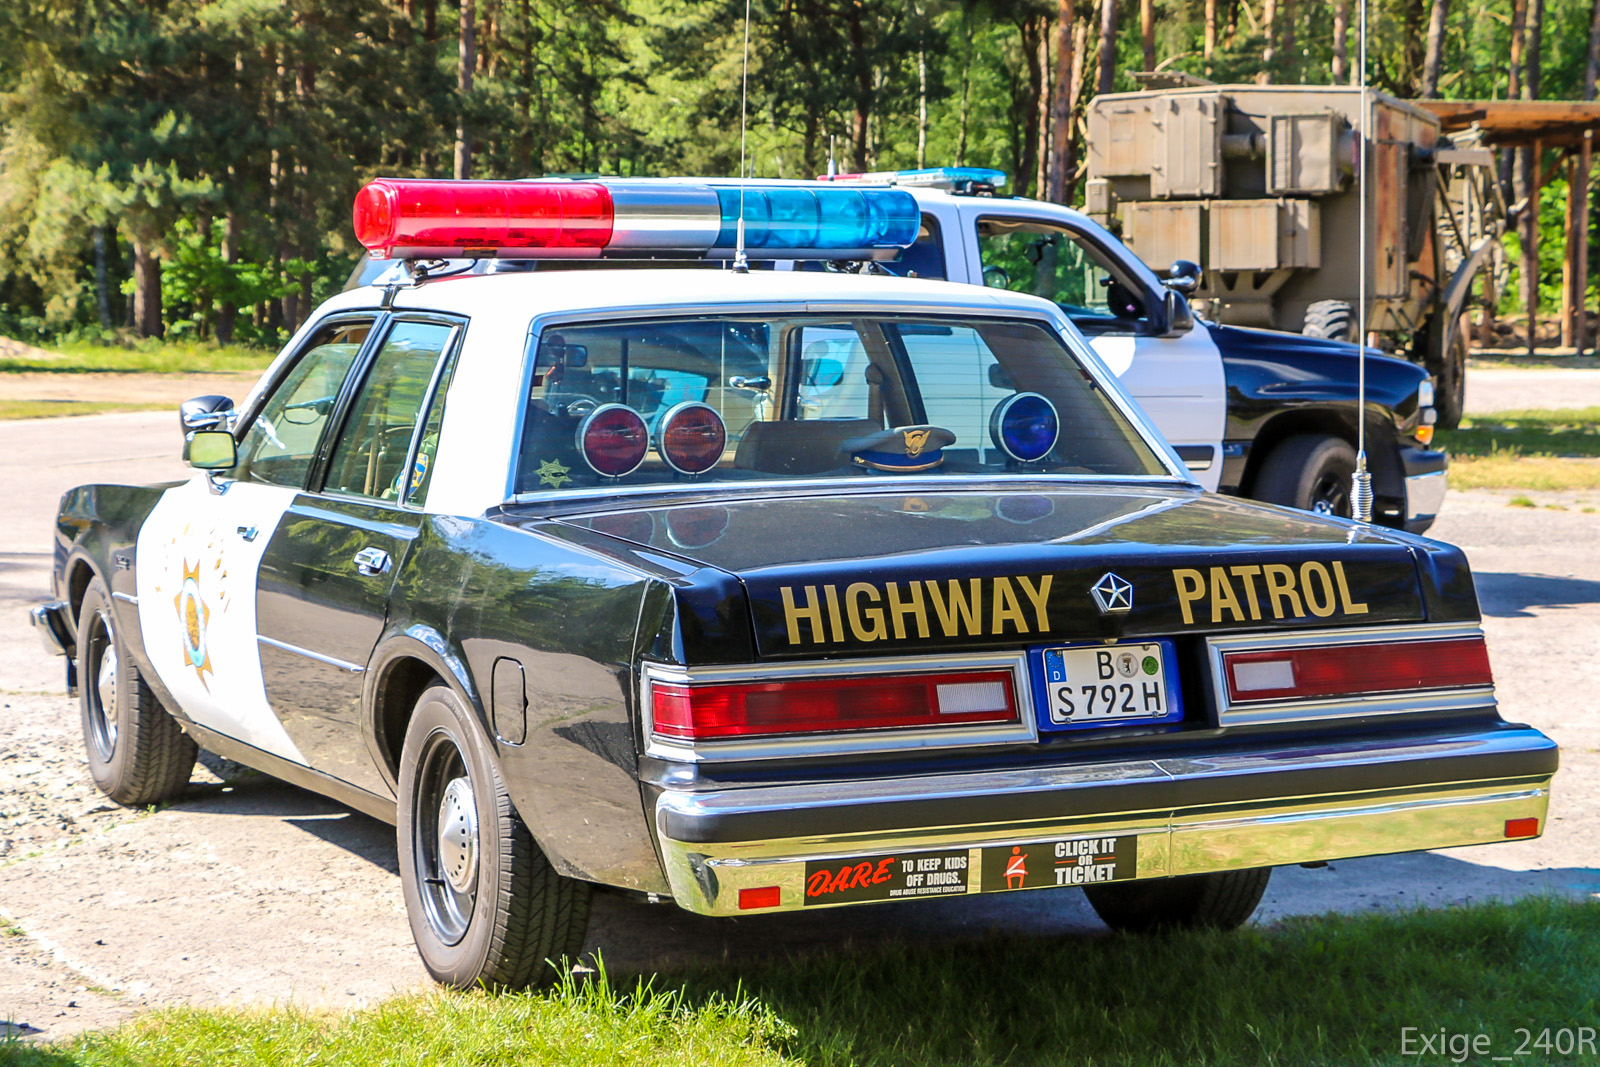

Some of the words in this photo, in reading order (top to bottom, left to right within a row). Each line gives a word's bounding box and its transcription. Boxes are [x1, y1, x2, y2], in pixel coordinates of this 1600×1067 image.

[780, 575, 1053, 645] HIGHWAY
[1172, 560, 1369, 625] PATROL
[1096, 651, 1115, 680] B
[1053, 671, 1061, 681] D
[1054, 839, 1099, 858] CLICK
[1101, 837, 1117, 854] IT
[902, 860, 914, 873] TO
[917, 858, 941, 872] KEEP
[944, 856, 967, 870] KIDS
[1078, 855, 1093, 866] OR
[906, 873, 924, 887] OFF
[926, 871, 961, 886] DRUGS.
[1054, 863, 1116, 885] TICKET
[889, 889, 902, 897] DRUG
[902, 888, 917, 896] ABUSE
[916, 886, 943, 895] RESISTANCE
[942, 885, 966, 893] EDUCATION
